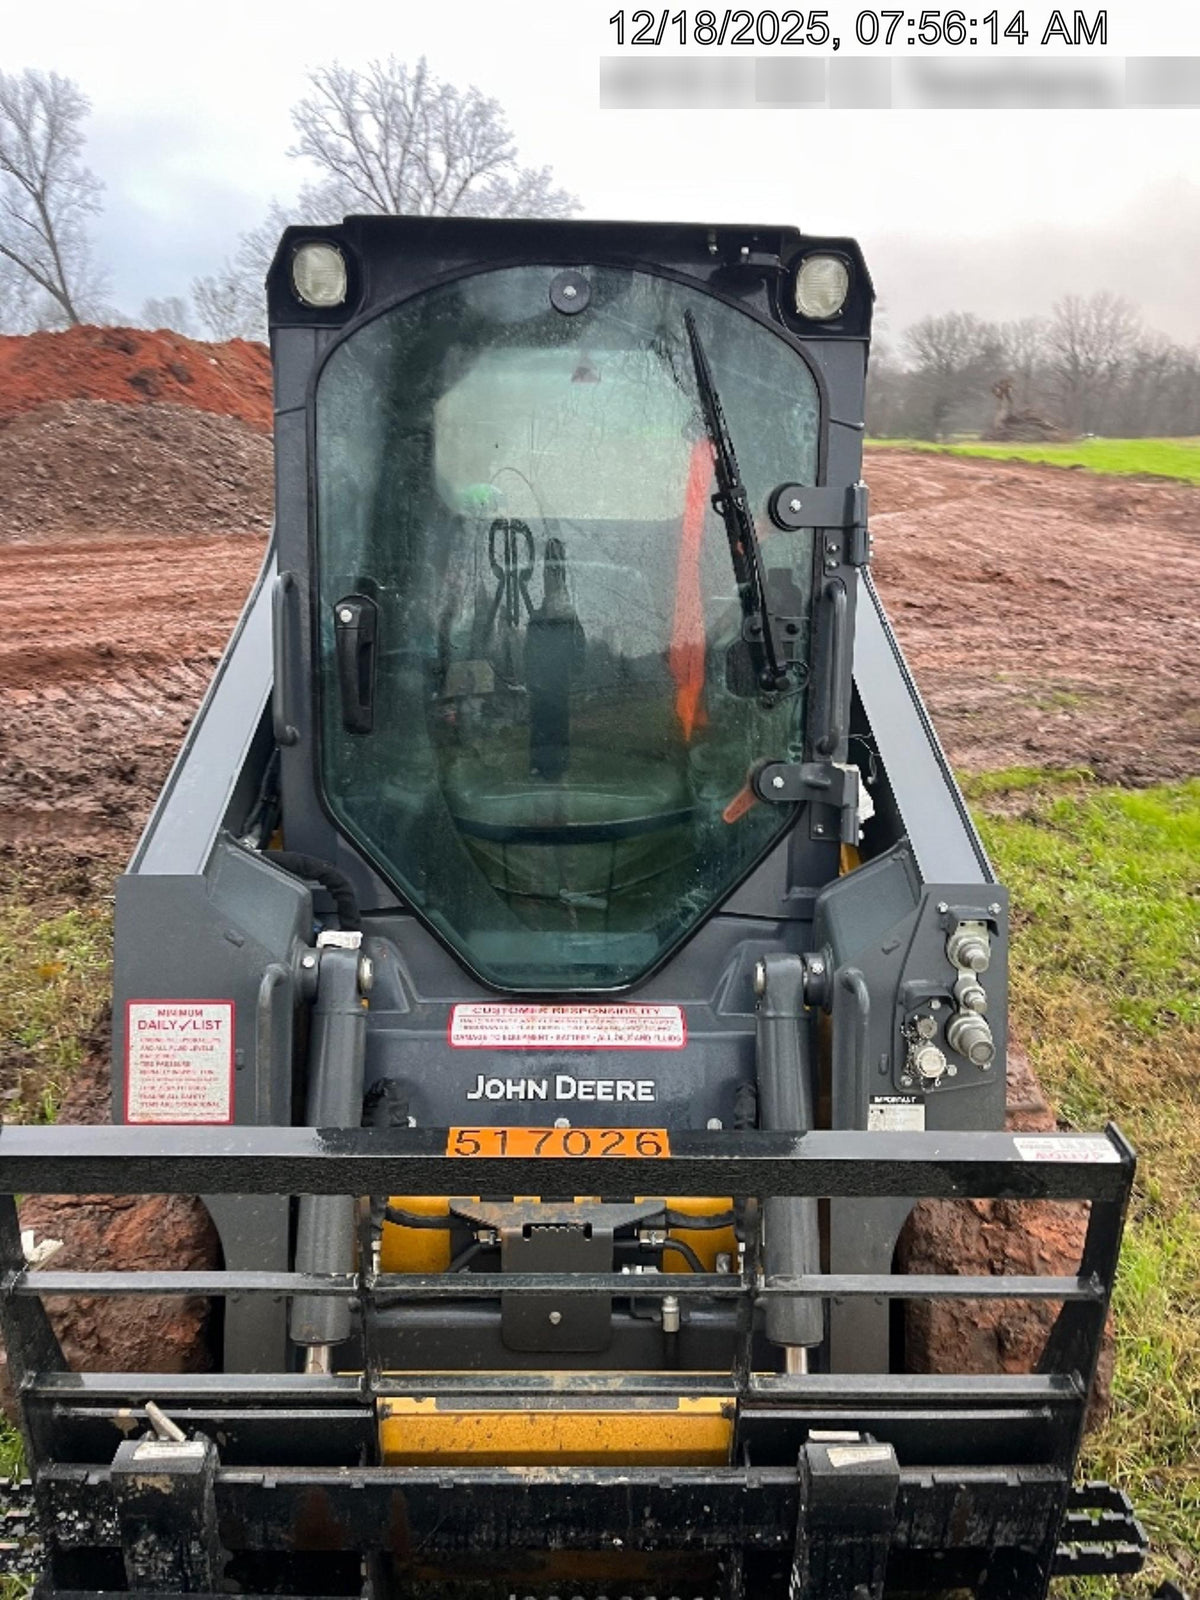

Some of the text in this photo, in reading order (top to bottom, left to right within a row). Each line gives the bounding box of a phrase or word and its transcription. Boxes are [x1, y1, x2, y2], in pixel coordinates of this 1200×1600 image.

[137, 1020, 222, 1030] DAILY LIST
[466, 1074, 656, 1101] JOHN DEERE
[454, 1129, 663, 1156] 517026
